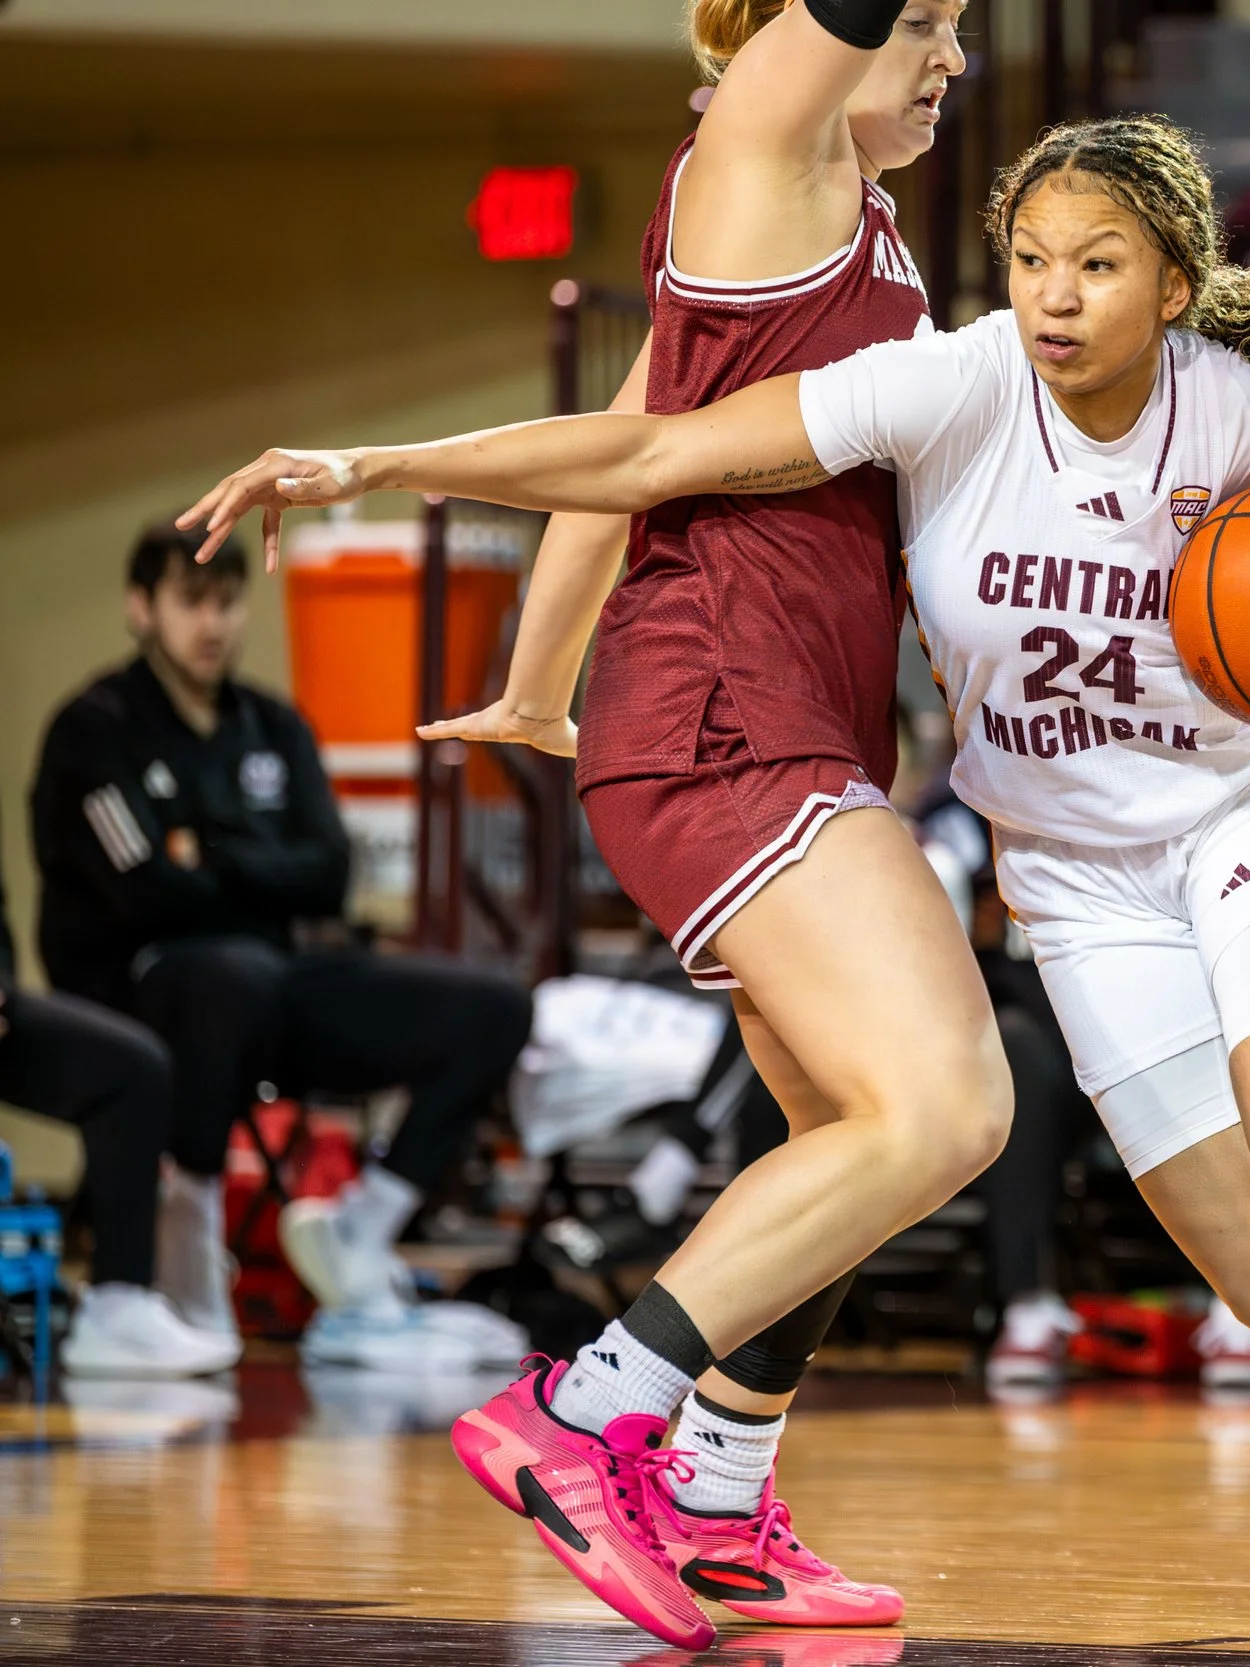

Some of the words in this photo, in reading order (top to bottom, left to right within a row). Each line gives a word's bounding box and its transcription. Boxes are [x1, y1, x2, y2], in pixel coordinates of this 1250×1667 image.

[721, 467, 751, 484] God
[753, 469, 764, 480] is
[768, 459, 809, 476] within
[1171, 500, 1207, 514] MAC
[978, 551, 1174, 620] CENTRA
[1021, 626, 1145, 705] 24
